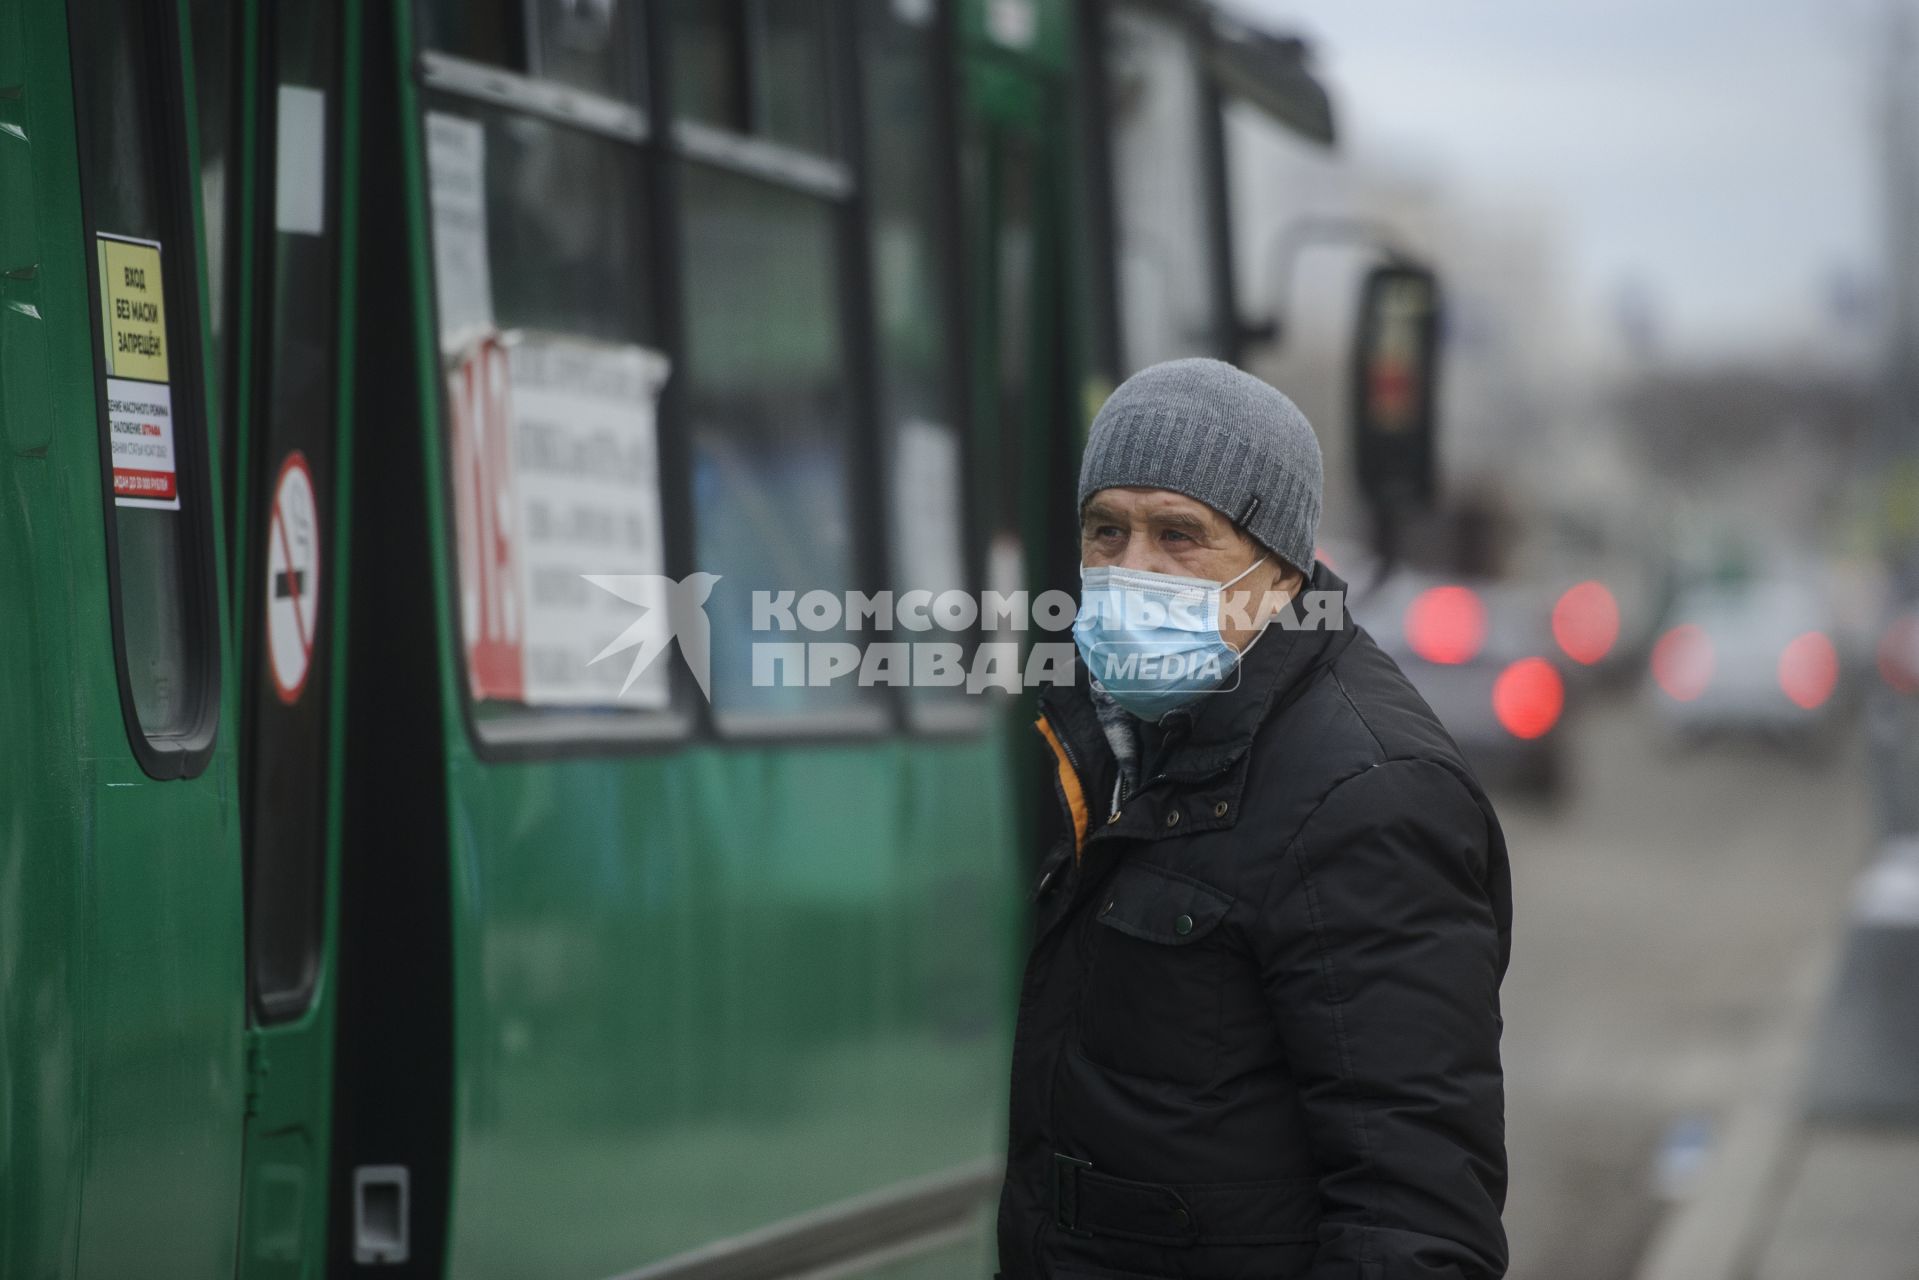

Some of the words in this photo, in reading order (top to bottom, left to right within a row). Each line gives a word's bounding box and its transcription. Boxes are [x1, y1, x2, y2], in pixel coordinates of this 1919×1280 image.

[124, 266, 147, 292] ВХОД
[116, 298, 130, 319] БЕЗ
[131, 301, 158, 324] МАСКИ
